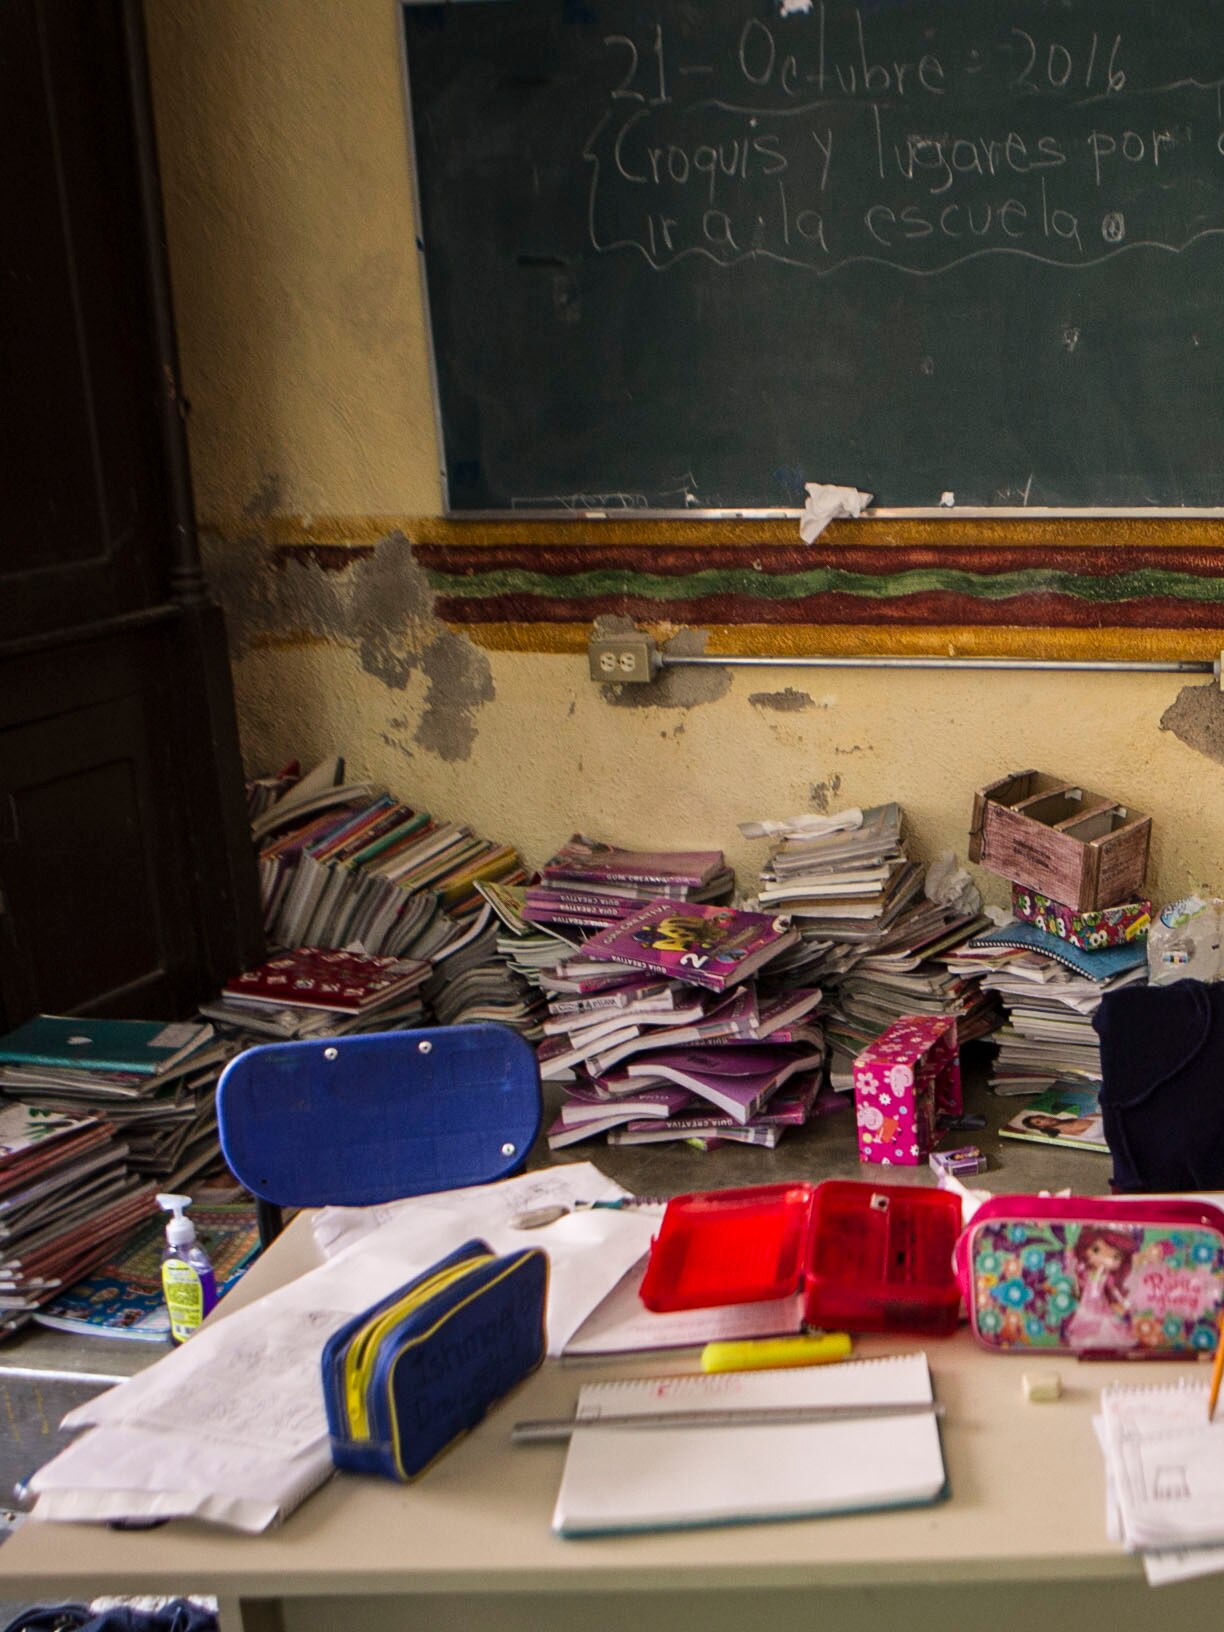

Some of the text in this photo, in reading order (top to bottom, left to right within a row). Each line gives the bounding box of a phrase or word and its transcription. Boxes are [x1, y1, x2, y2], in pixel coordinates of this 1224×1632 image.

[604, 25, 672, 103] 21
[738, 0, 945, 96] Octubre
[1011, 28, 1127, 93] 2016
[615, 110, 789, 202] Croquis
[812, 128, 834, 192] y
[1088, 129, 1172, 187] por
[647, 214, 677, 256] ir
[702, 209, 739, 250] a
[779, 180, 830, 254] la
